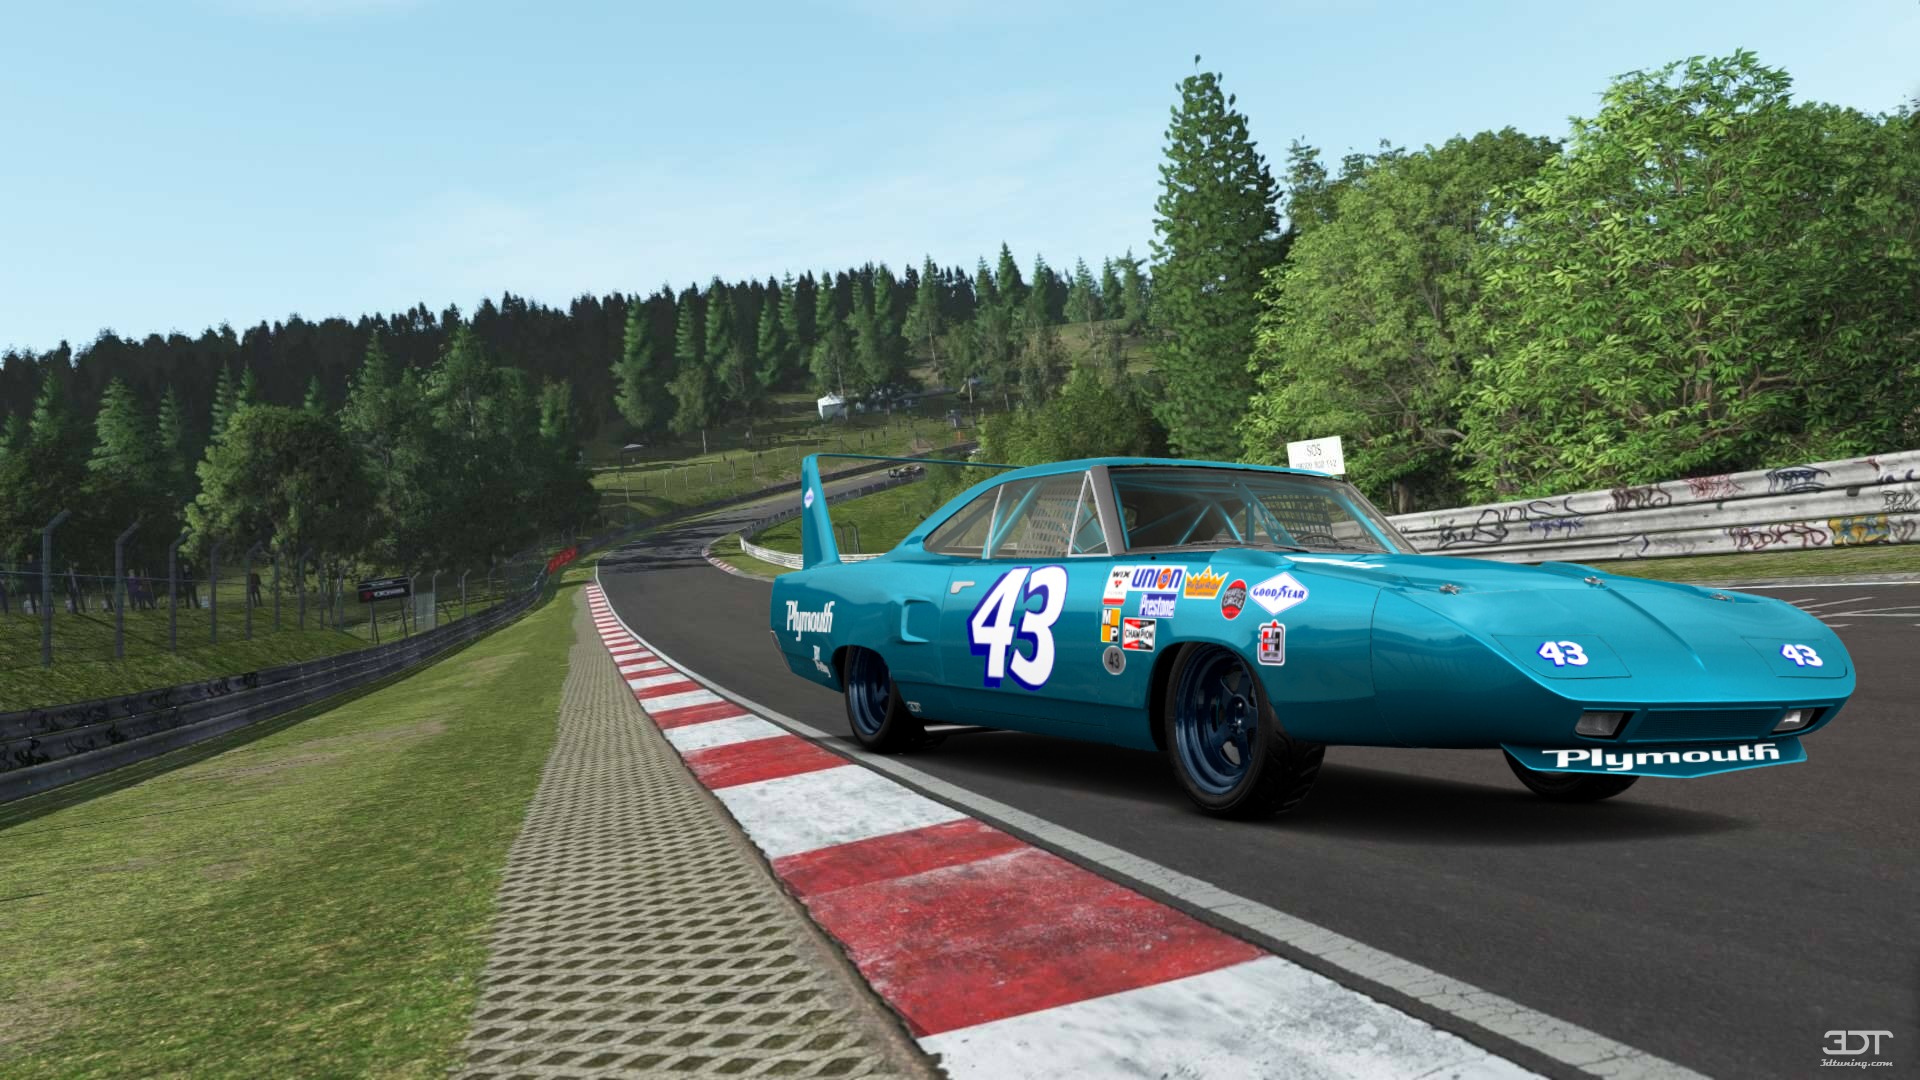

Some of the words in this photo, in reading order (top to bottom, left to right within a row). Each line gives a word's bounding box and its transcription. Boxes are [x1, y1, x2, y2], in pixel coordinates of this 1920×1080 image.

[1306, 444, 1322, 456] SOS
[1131, 568, 1183, 589] UNION
[1140, 595, 1175, 617] Prestone
[1222, 597, 1244, 609] CIRCLE
[785, 599, 836, 642] Plymouth
[967, 565, 1068, 691] 43
[1125, 628, 1153, 640] CHAMPION
[1108, 652, 1120, 669] 43
[1536, 640, 1590, 668] 43
[1779, 643, 1824, 668] 43
[1542, 742, 1780, 772] Plymouth
